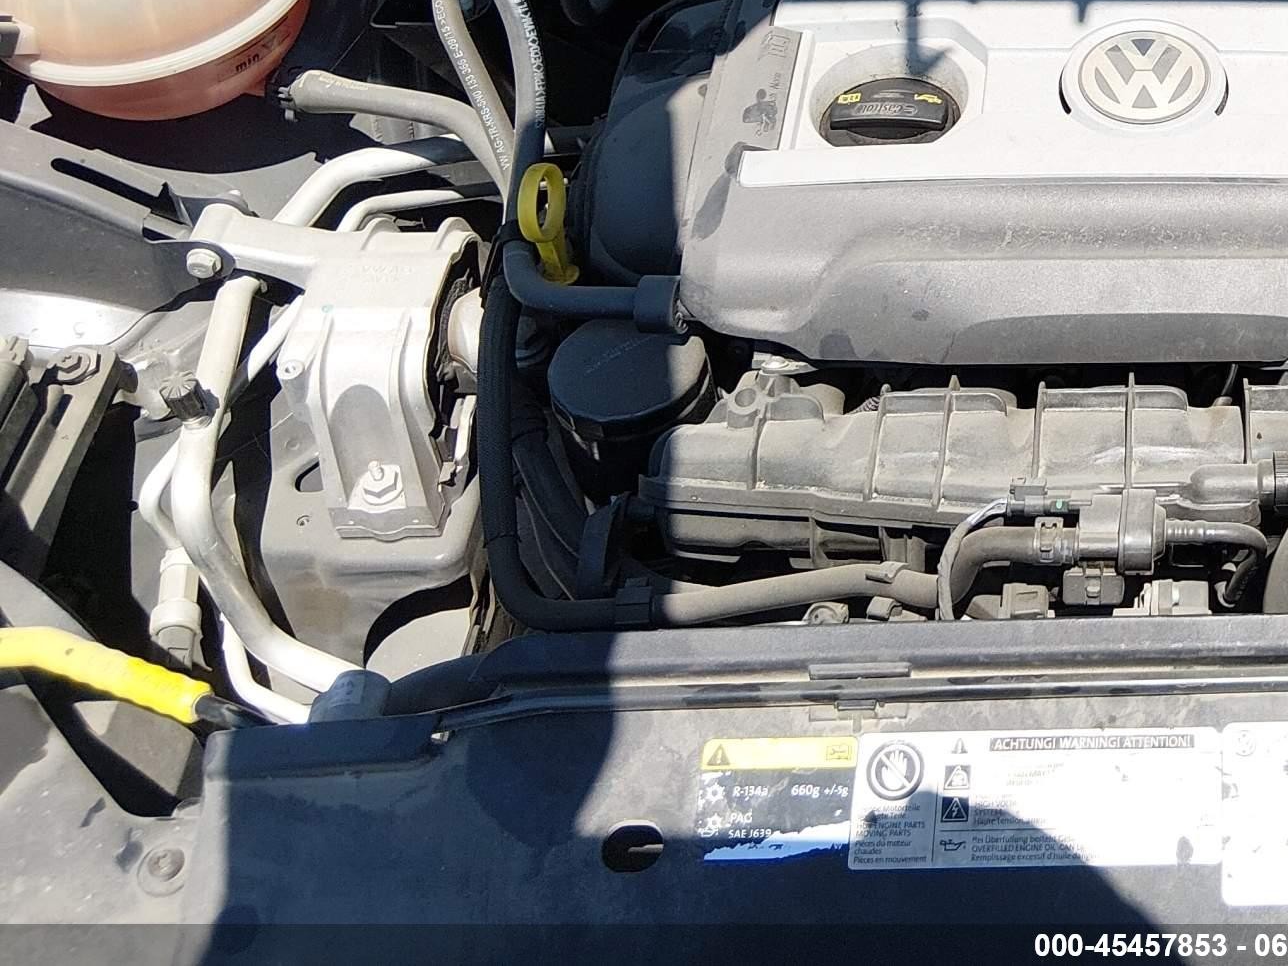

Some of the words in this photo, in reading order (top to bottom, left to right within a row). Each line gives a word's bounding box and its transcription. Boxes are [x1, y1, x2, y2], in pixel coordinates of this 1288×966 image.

[235, 53, 261, 73] min
[465, 75, 479, 89] 133
[499, 155, 511, 170] VW
[994, 737, 1056, 750] ACHTUNG!
[1059, 736, 1121, 749] WARNING!
[1124, 734, 1191, 748] ATTENTION!
[732, 785, 769, 797] R-134a
[790, 784, 820, 798] 660g
[823, 784, 849, 797] +/-5g
[729, 814, 752, 823] PAG
[875, 821, 902, 829] ENGINE
[904, 821, 926, 829] PARTS
[728, 829, 745, 838] SAE
[747, 828, 772, 838] J639
[855, 829, 888, 838] MOVING
[889, 829, 912, 837] PARTS
[971, 844, 1014, 852] OVERFILLED
[1015, 843, 1043, 852] ENGINE
[1044, 843, 1057, 851] OIL
[885, 856, 927, 864] mouvement
[971, 853, 1016, 863] Remplissage
[1017, 852, 1045, 860] excessif
